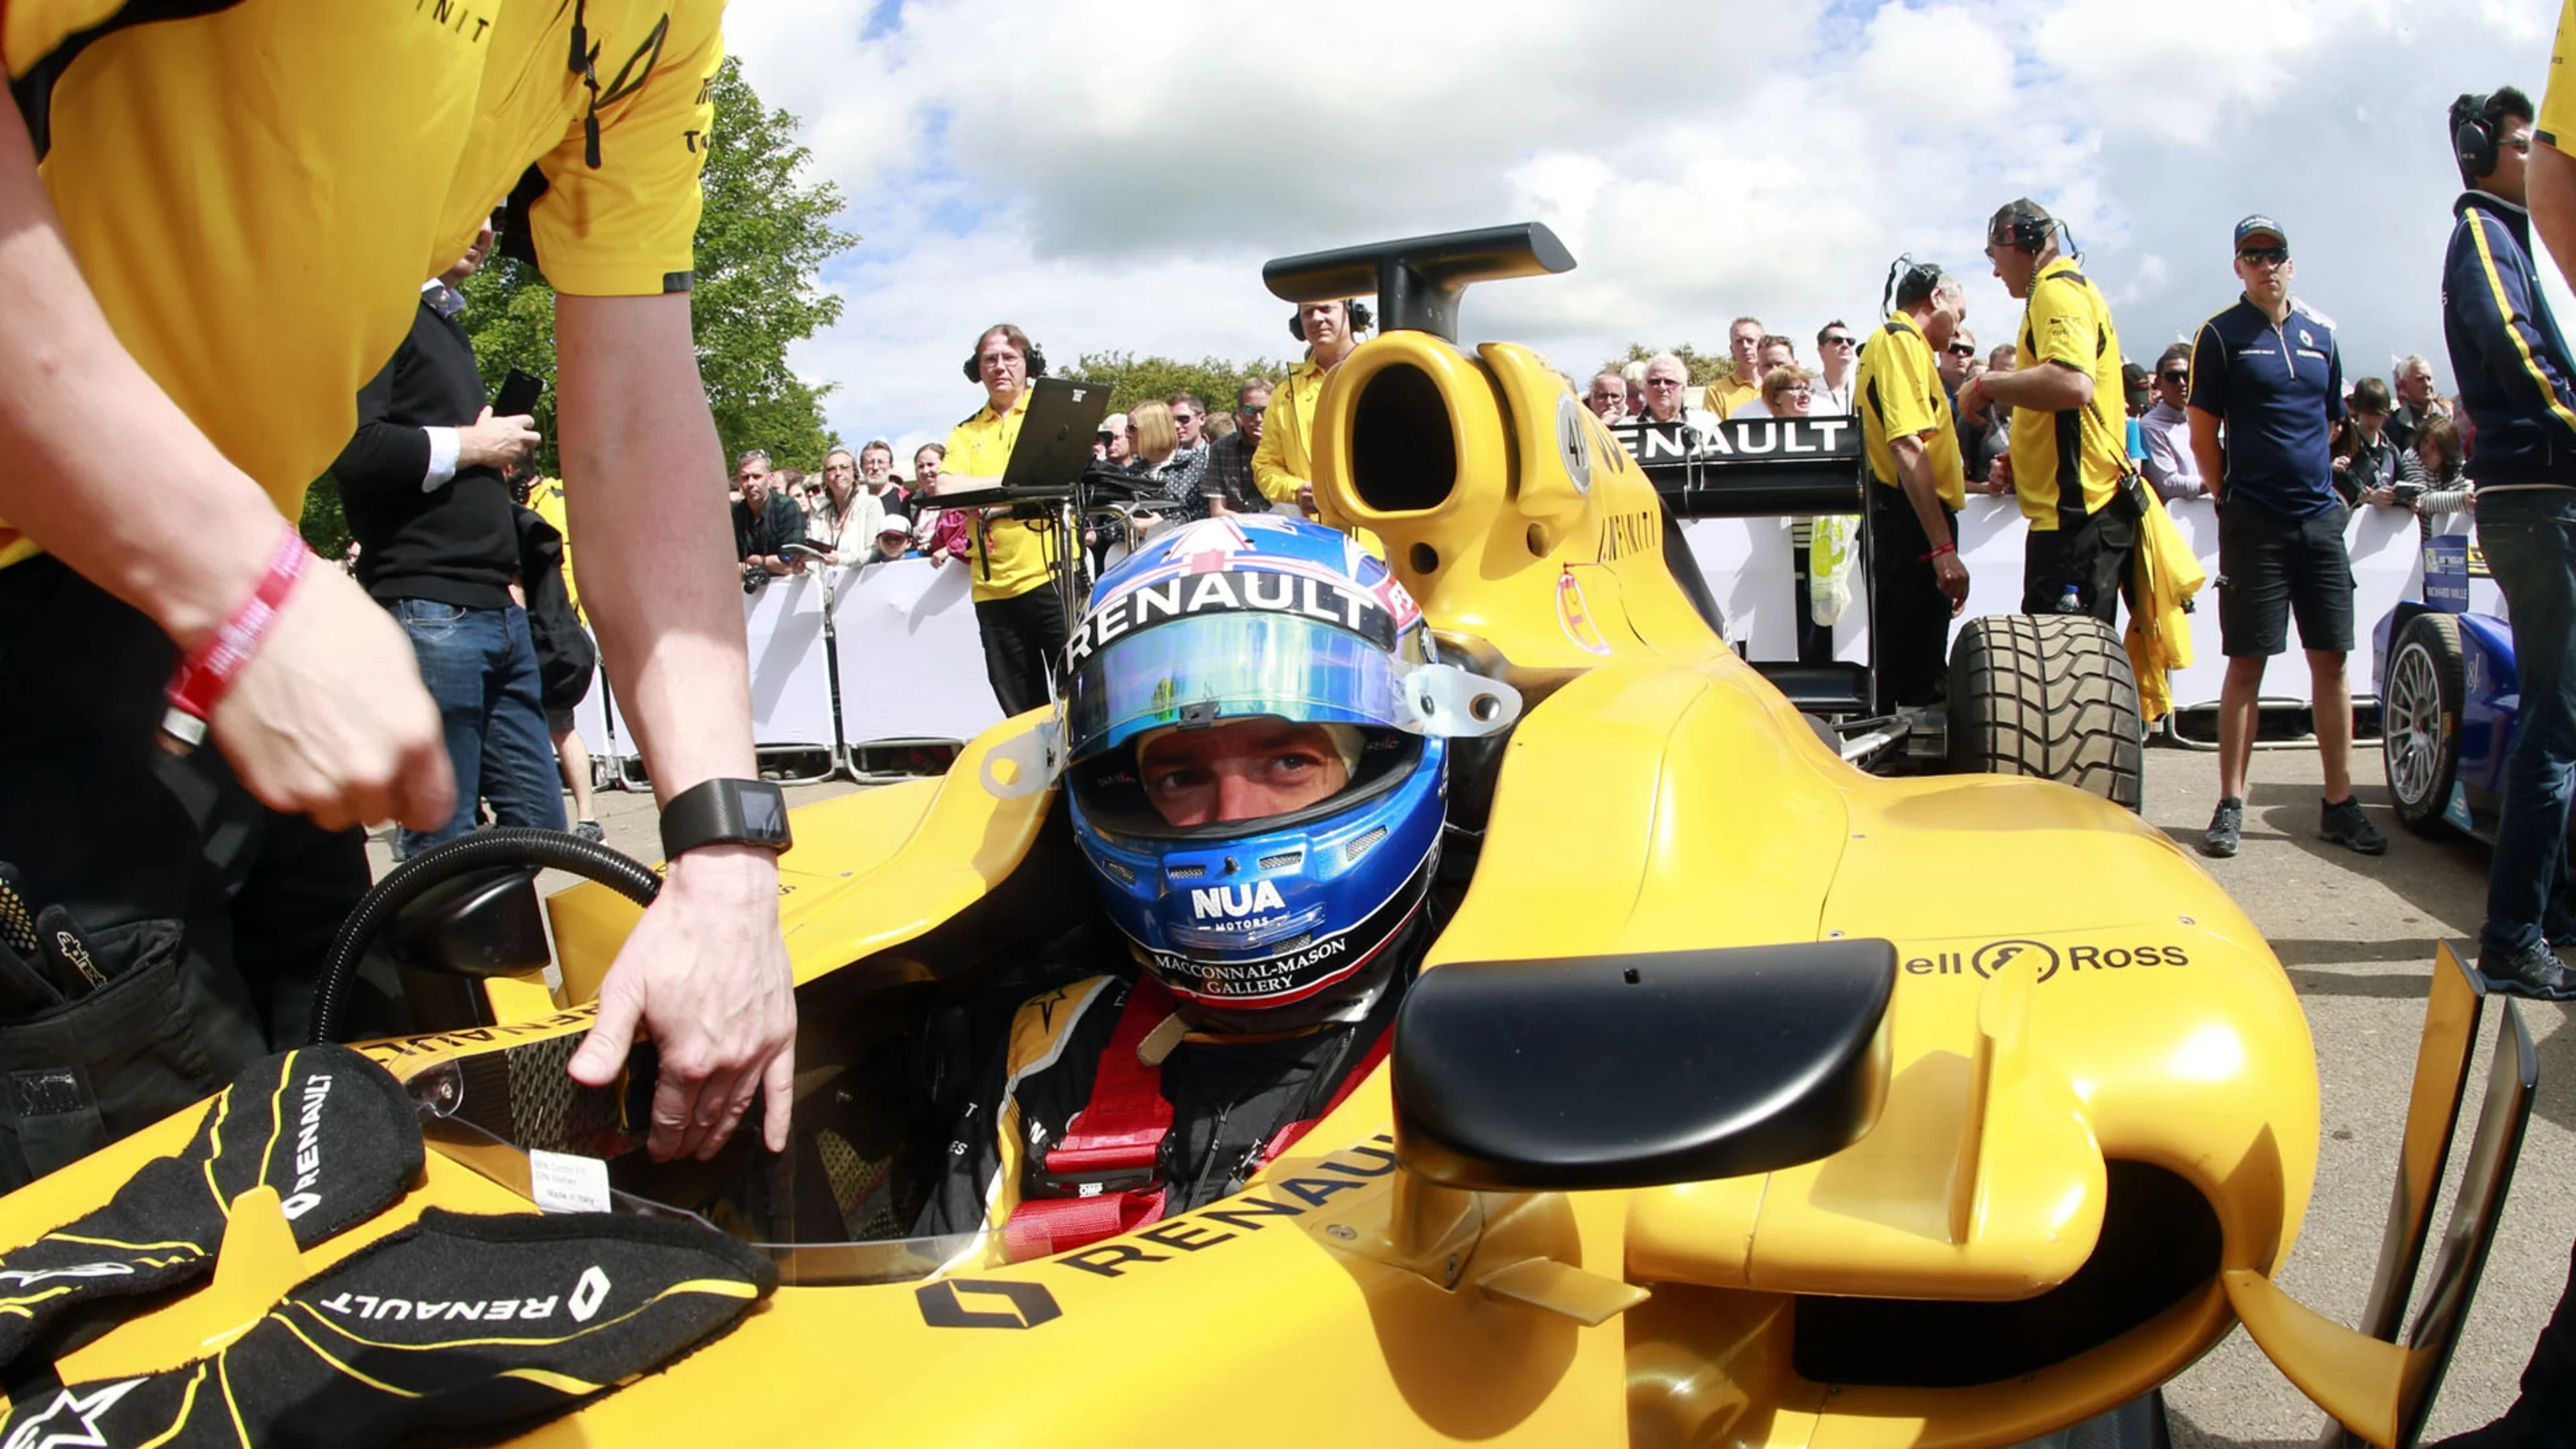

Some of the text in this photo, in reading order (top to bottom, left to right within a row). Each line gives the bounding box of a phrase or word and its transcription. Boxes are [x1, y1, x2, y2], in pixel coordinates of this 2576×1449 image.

[1065, 571, 1374, 675] RENAULT
[1191, 879, 1286, 919] NUA
[1215, 916, 1269, 931] MOTORS
[1154, 939, 1346, 980] MACCONNAL-MASON
[1207, 975, 1293, 995] GALLERY
[292, 1074, 333, 1194] RENAULT
[320, 1292, 559, 1321] RENAULT
